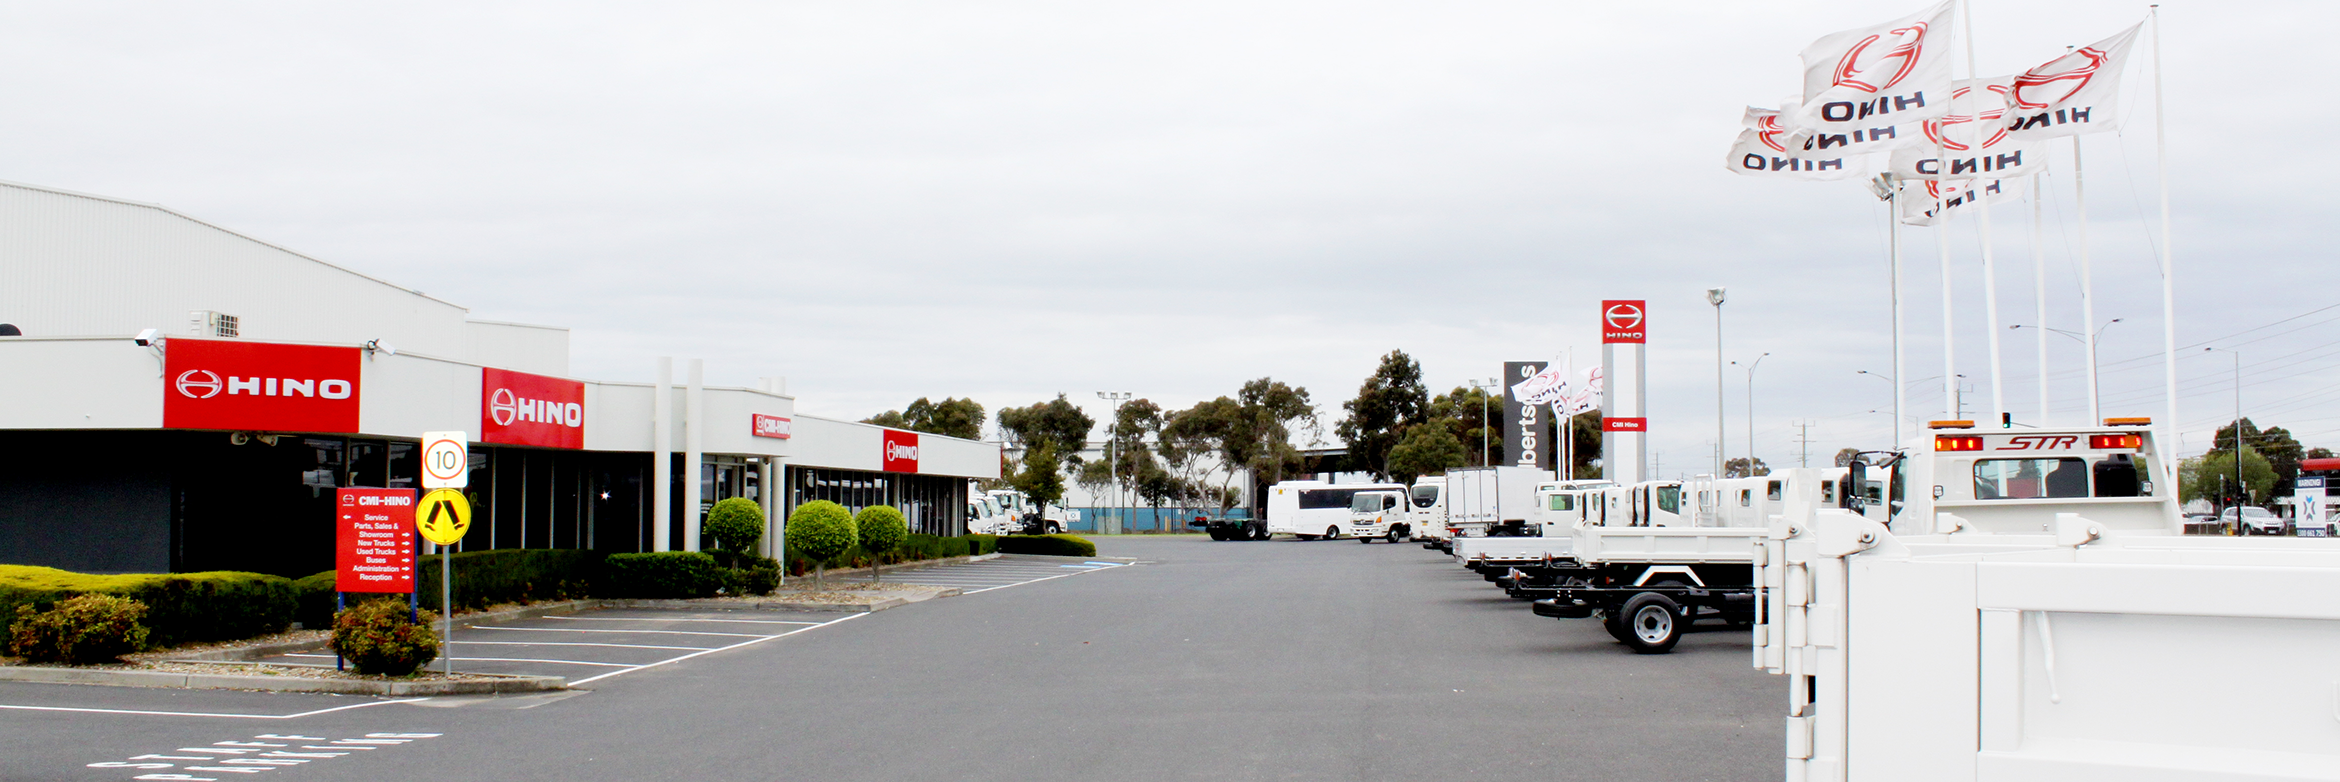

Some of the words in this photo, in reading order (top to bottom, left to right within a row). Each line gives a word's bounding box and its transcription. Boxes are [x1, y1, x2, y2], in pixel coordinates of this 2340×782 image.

[227, 375, 352, 400] HINO
[518, 398, 583, 428] HINO
[1517, 364, 1537, 468] lbertss
[1995, 435, 2078, 450] STR
[434, 450, 456, 470] 10
[895, 445, 918, 461] HINO
[359, 496, 411, 506] CMI-HINO
[359, 574, 393, 582] Reception
